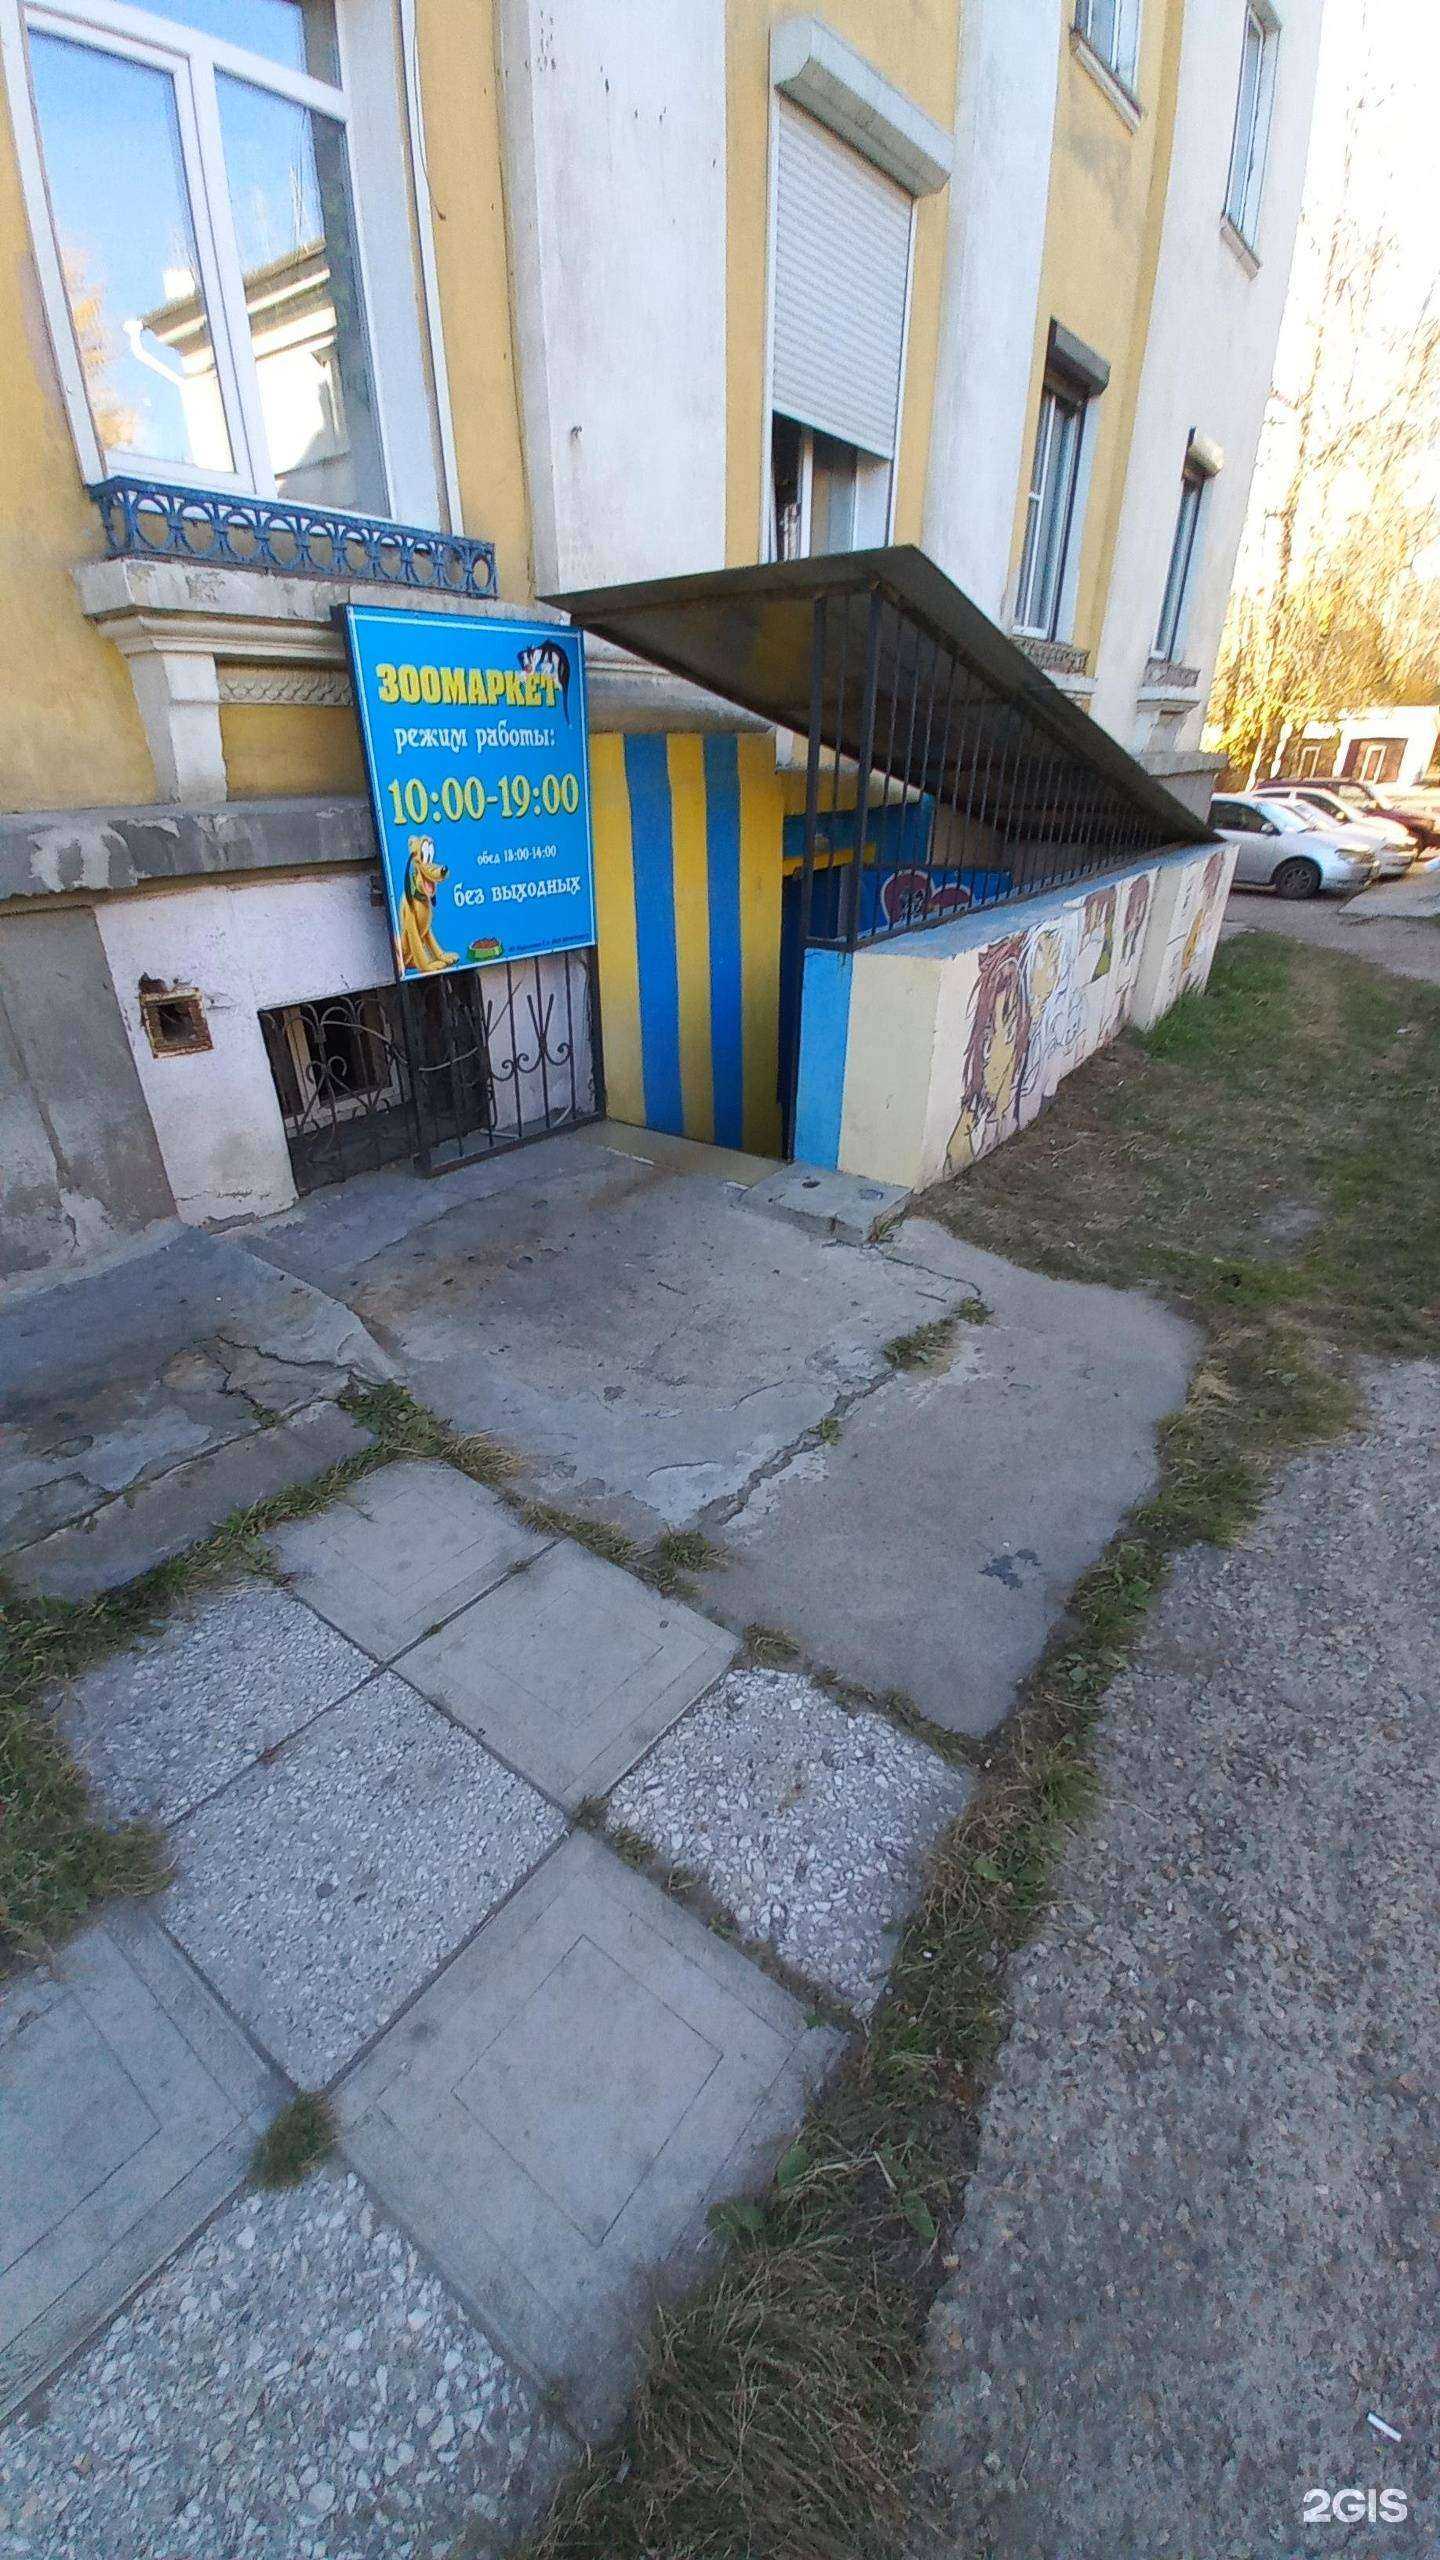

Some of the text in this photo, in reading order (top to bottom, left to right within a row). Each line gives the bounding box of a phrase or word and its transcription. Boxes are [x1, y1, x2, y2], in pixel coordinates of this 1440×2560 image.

[375, 663, 560, 707] ЗООМАРКЕТ
[393, 719, 555, 755] режим работы:
[388, 773, 580, 825] 10:00-19:00
[477, 851, 501, 866] обед
[453, 876, 581, 907] без выходных
